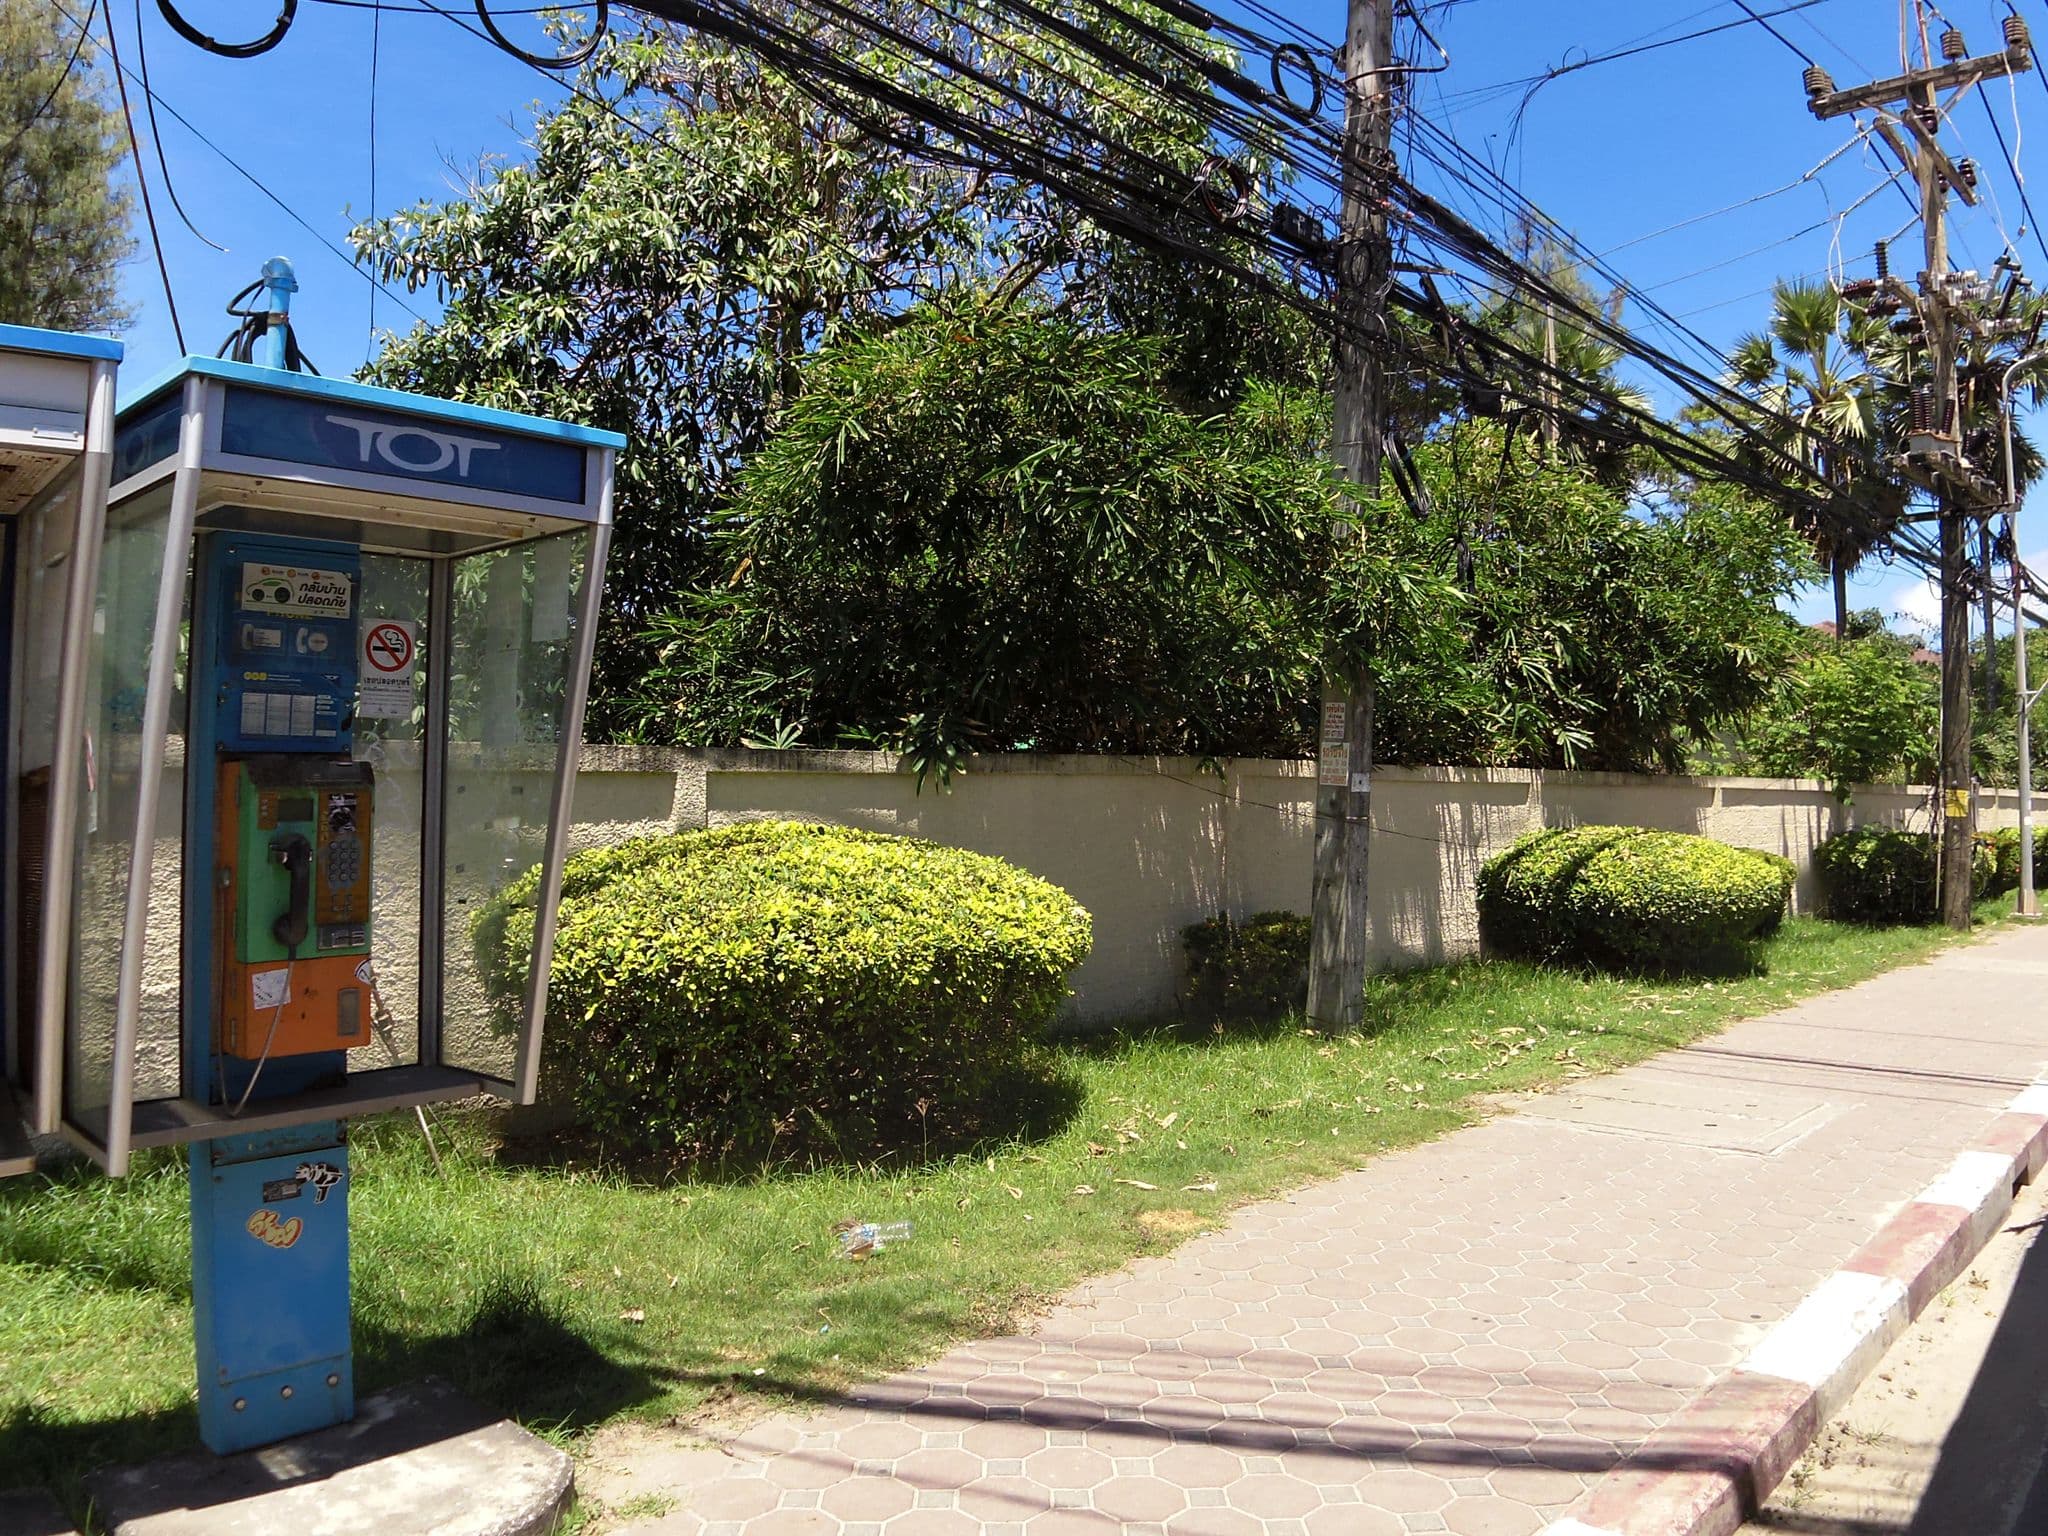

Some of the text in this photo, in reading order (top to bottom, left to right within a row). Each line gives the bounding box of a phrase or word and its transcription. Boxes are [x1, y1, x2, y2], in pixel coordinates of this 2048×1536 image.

[325, 414, 502, 478] TOT
[299, 581, 346, 596] กลับบ้าน
[297, 593, 347, 608] ปลอดภัย
